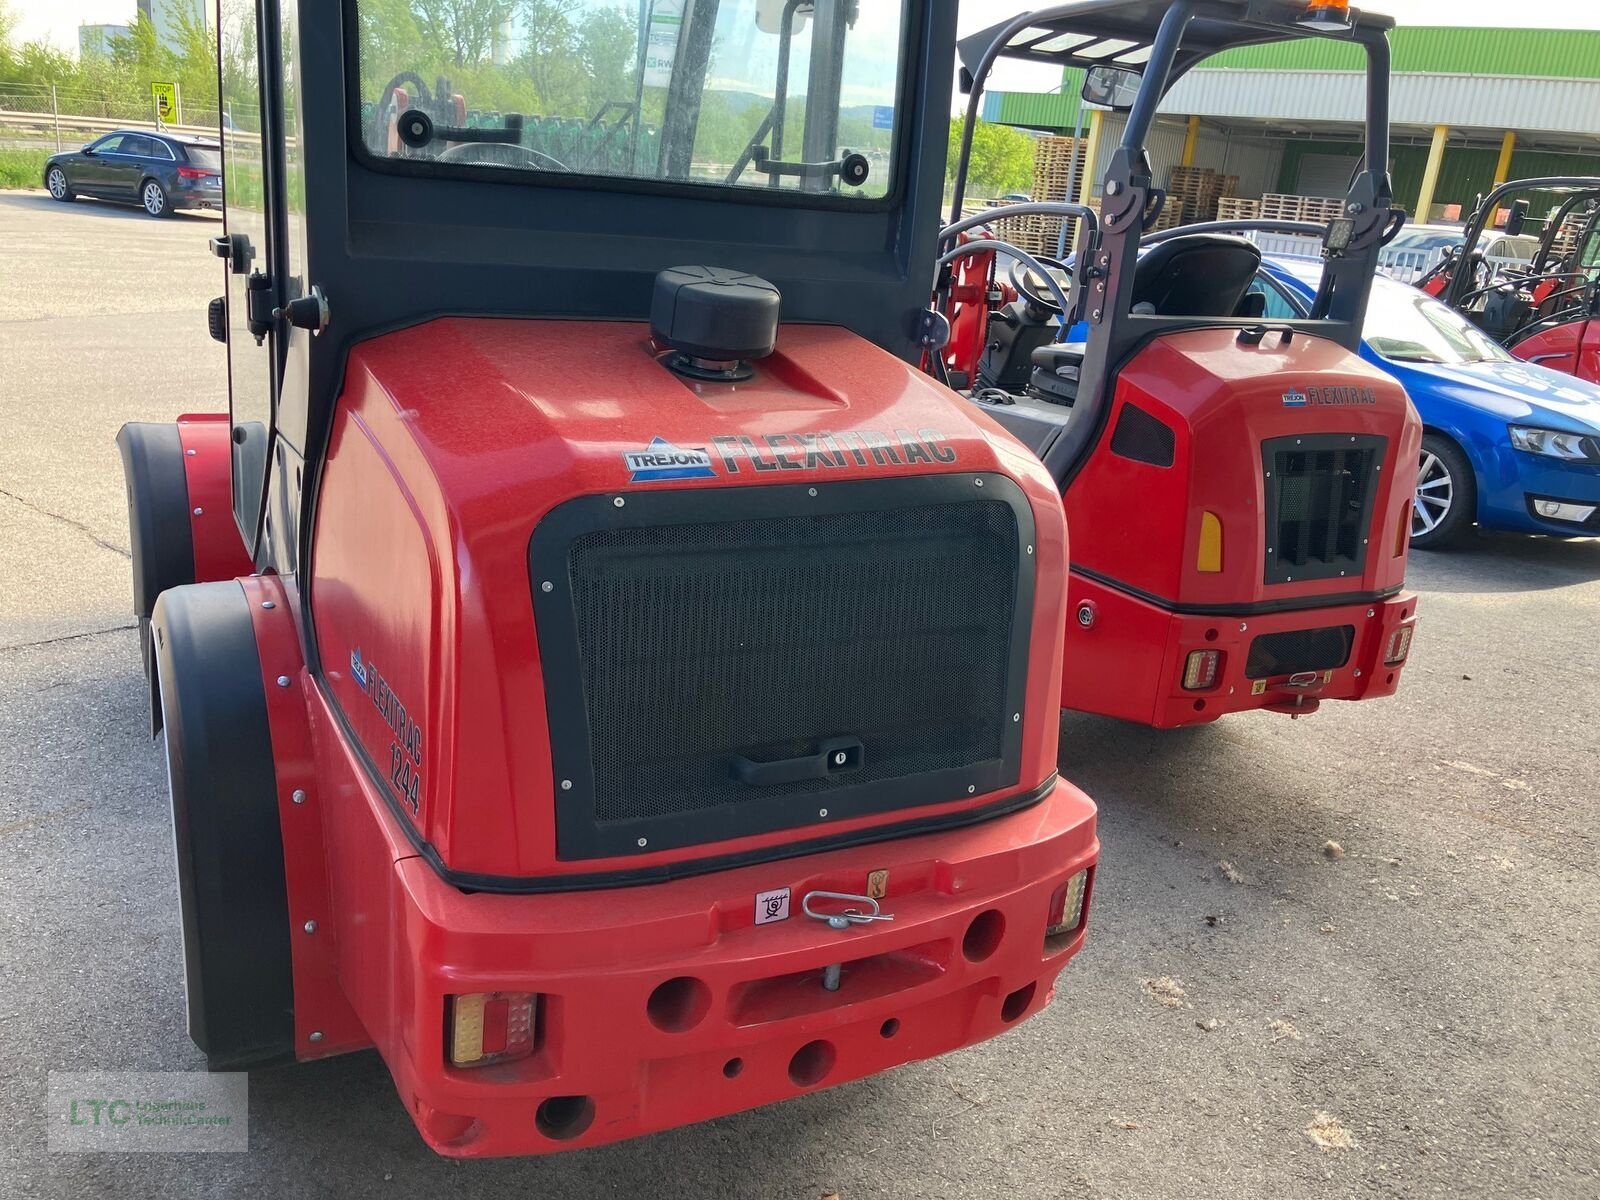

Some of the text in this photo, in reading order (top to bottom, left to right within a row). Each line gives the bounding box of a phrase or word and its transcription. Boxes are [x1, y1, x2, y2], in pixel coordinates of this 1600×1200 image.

[155, 85, 172, 93] STOP
[1307, 386, 1377, 405] FLEXITRAC
[629, 429, 956, 473] TREJON FLEXITRAC
[368, 662, 421, 767] FLEXITRAC
[390, 741, 420, 818] 1244
